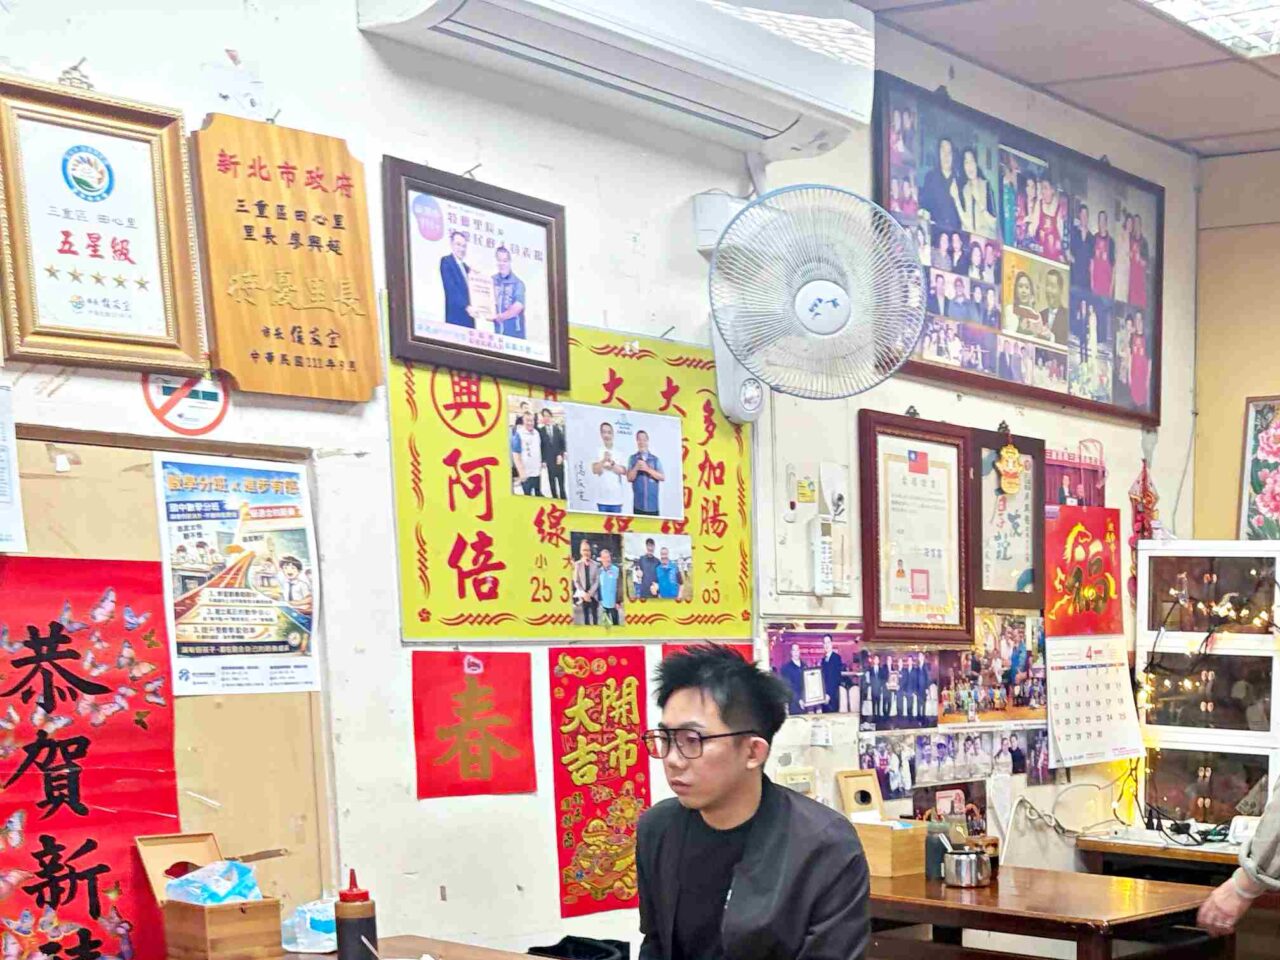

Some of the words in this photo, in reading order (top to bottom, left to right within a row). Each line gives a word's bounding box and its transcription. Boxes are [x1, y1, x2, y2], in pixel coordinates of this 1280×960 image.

[216, 149, 354, 198] 新北市政府
[236, 199, 346, 230] 三重區田心里
[57, 229, 137, 265] 五星級
[243, 225, 278, 246] 里長
[705, 559, 717, 573] 大
[1086, 646, 1093, 661] 4
[434, 675, 522, 780] 春
[560, 685, 603, 787] 大吉
[601, 676, 641, 777] 開市
